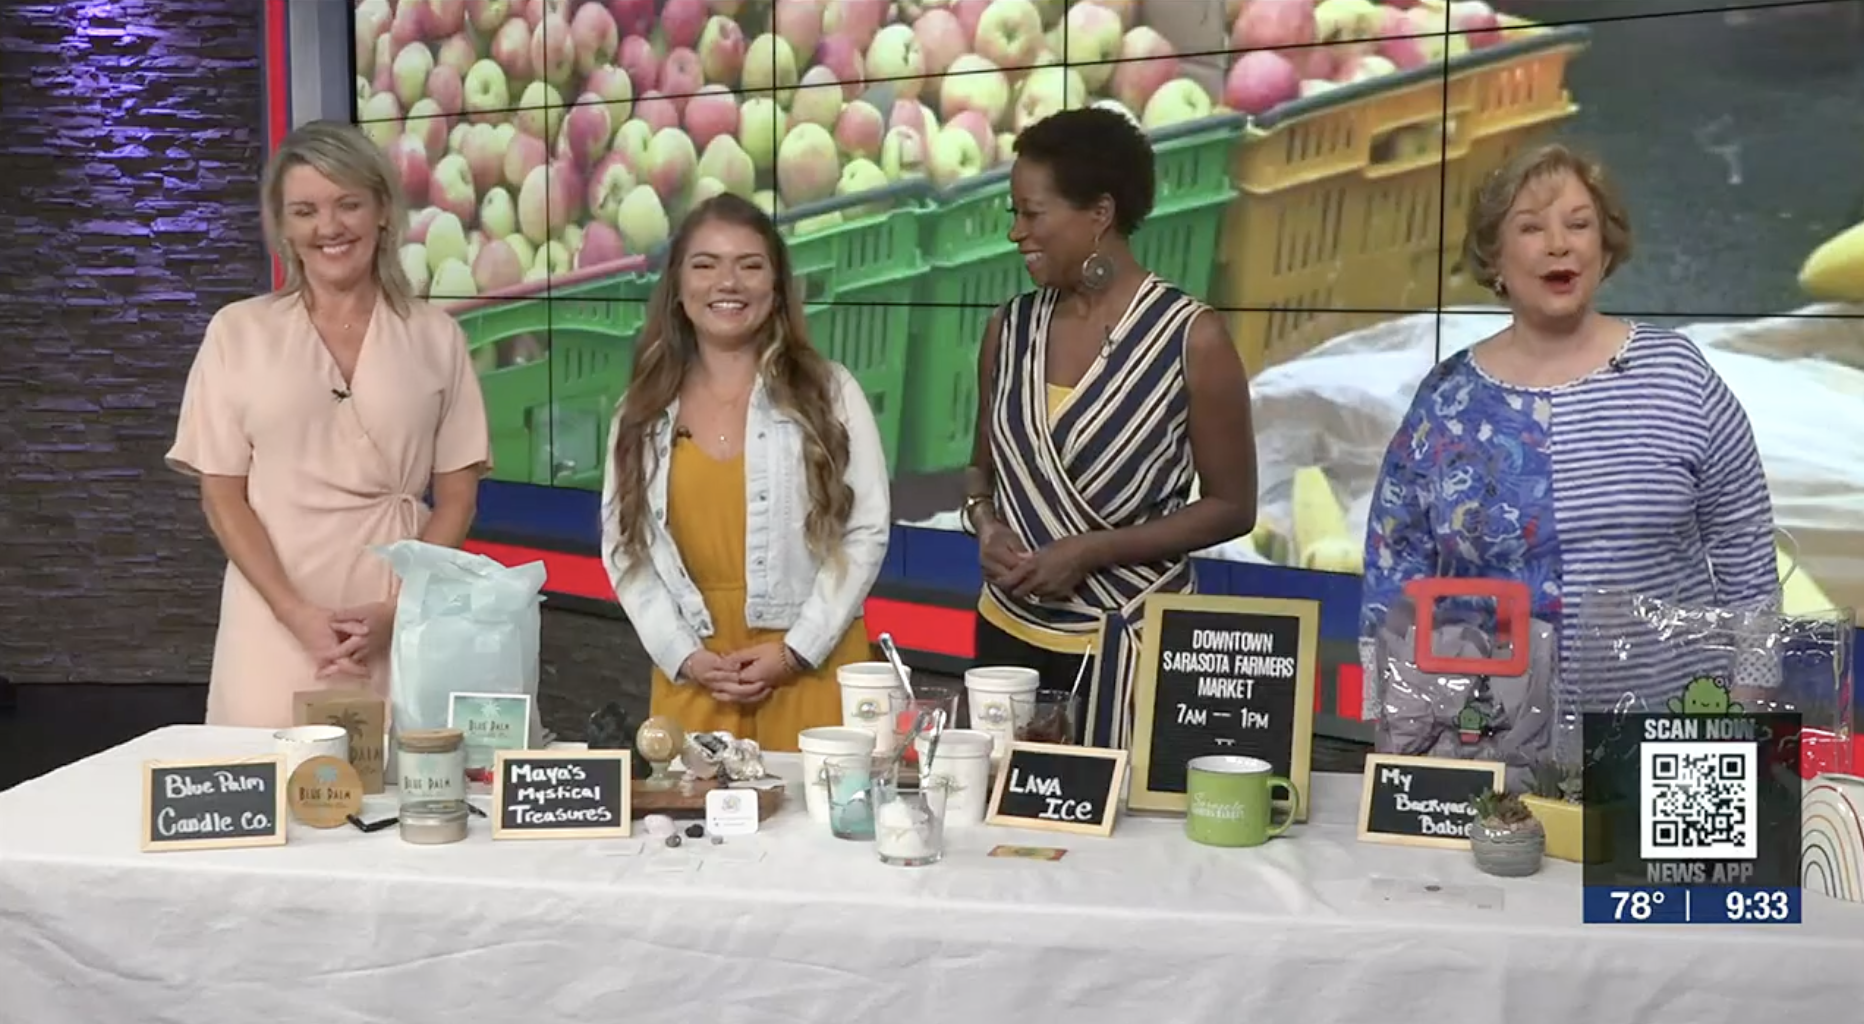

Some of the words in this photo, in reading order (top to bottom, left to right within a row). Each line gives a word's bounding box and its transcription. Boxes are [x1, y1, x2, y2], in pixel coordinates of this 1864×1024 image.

[1192, 629, 1274, 654] DOWNTOWN
[1163, 651, 1230, 673] SARASOTA
[1234, 654, 1295, 678] FARMERS
[1198, 677, 1255, 700] MARKET
[1177, 703, 1207, 726] 7AM
[1240, 707, 1269, 729] 1PM
[165, 773, 215, 798] Blue
[213, 770, 265, 793] Palm
[511, 764, 587, 785] Maya's
[1009, 767, 1062, 796] LAVA
[1381, 768, 1413, 792] My
[518, 785, 600, 805] Mystical
[157, 806, 234, 836] Candle
[241, 811, 271, 830] Co.
[508, 804, 612, 824] Treasures
[1418, 815, 1474, 836] Babie
